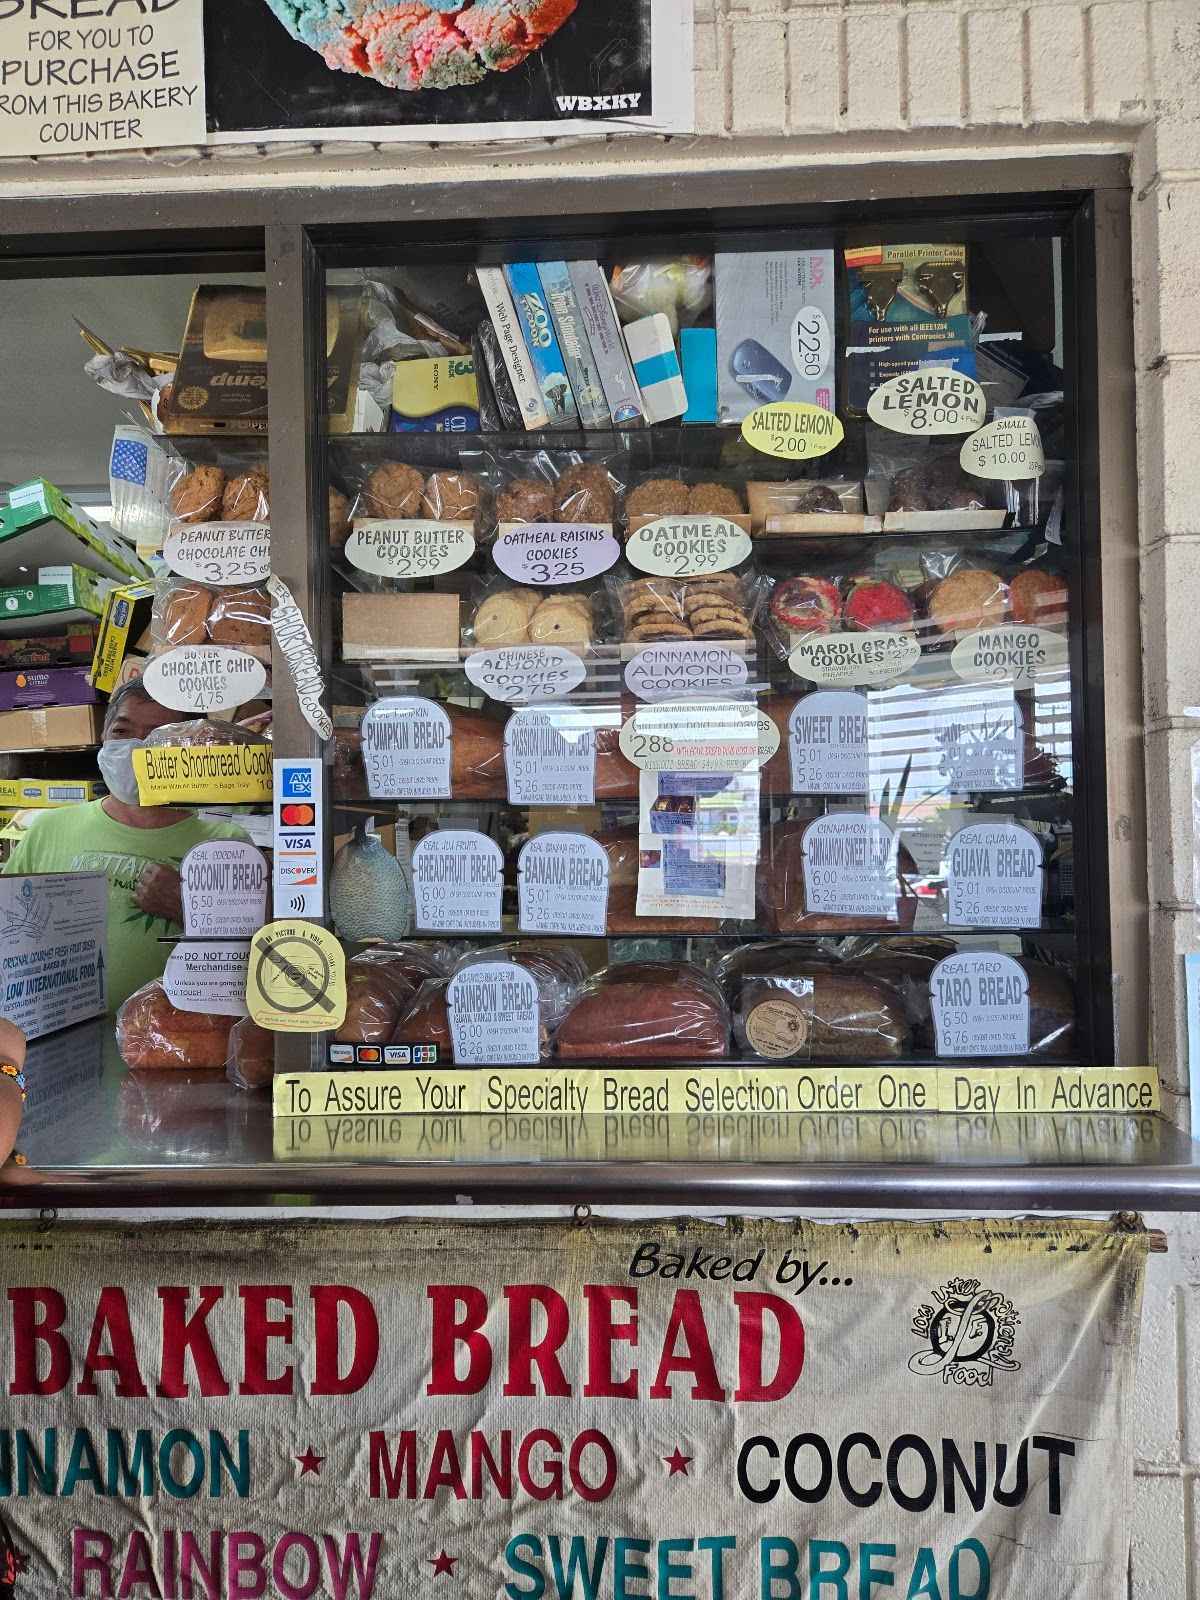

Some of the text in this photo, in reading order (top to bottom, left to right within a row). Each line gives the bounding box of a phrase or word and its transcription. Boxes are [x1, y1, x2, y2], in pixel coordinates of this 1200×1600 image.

[28, 24, 154, 50] FOR YOU TO
[1, 50, 180, 87] PURCHASE
[53, 85, 198, 114] THIS BAKERY
[556, 93, 641, 111] WBXKY
[39, 118, 142, 143] COUNTER
[887, 251, 916, 259] Parallel
[917, 249, 943, 257] Printer
[519, 297, 540, 348] TYCOON
[525, 292, 552, 348] ZOO
[893, 325, 909, 333] with
[496, 301, 526, 383] Web Page Designer
[797, 314, 821, 376] $22.50
[868, 335, 894, 344] printers
[911, 333, 946, 341] Centronics
[896, 375, 976, 394] SALTED
[883, 393, 978, 414] LEMON
[752, 411, 834, 435] SALTED LEMON
[904, 408, 958, 429] $8.00
[996, 420, 1027, 431] SMALL
[771, 434, 807, 453] $2.00
[972, 434, 1013, 452] SALTED
[180, 529, 271, 544] PEANUT BUTTER
[357, 528, 465, 546] PEANUT BUTTER
[503, 529, 605, 546] OATMEAL RAISINS
[639, 523, 741, 542] OATMEAL
[177, 546, 246, 560] CHOCOLATE
[376, 544, 449, 559] COOKIES
[526, 547, 579, 562] COOKIES
[652, 539, 727, 558] COOKIES
[195, 561, 257, 582] $3.25
[387, 556, 441, 577] $2.99
[521, 562, 585, 583] $3.25
[664, 554, 719, 575] $2.99
[272, 605, 324, 695] SHORTBREAD
[800, 636, 908, 656] MARDI GRAS
[978, 633, 1040, 649] MANGO
[481, 656, 563, 671] ALMOND
[498, 648, 546, 661] CHINESE
[642, 650, 732, 663] CINNAMON
[810, 652, 884, 667] COOKIES
[974, 650, 1046, 667] COOKIES
[161, 658, 255, 677] CHOCLATE CHIP
[632, 664, 742, 677] ALMOND
[27, 674, 50, 682] SUMO
[178, 675, 228, 693] COOKIES
[483, 670, 568, 686] COOKIES
[187, 691, 224, 711] $4.75
[367, 721, 445, 751] PUMPKIN BREAD
[795, 715, 833, 745] SWEET
[512, 728, 539, 756] PASSION
[145, 746, 241, 780] Butter Shortbread
[370, 754, 394, 771] $5.01
[797, 747, 821, 764] $5.01
[513, 760, 537, 776] $5.01
[797, 766, 822, 783] $5.26
[291, 773, 312, 783] AM
[372, 773, 396, 789] $5.26
[514, 779, 538, 795] $5.26
[817, 823, 867, 835] CINNAMON
[284, 838, 312, 849] VISA
[423, 840, 478, 851] REAL FRUITS
[960, 833, 1017, 846] REAL GUAVA
[192, 849, 246, 861] REAL COCONUT
[808, 837, 867, 867] CINNAMON SWEET
[280, 867, 315, 875] DISCOVER
[418, 854, 497, 883] BREADFRUIT BREAD
[524, 855, 604, 886] BANANA BREAD
[952, 847, 991, 878] GUAVA
[997, 848, 1036, 878] BREAD
[187, 863, 263, 892] COCONUT BREAD
[810, 868, 837, 886] $6.00
[420, 884, 446, 902] $6.00
[526, 886, 550, 904] $5.01
[811, 887, 837, 904] $6.26
[953, 880, 979, 898] $5.01
[189, 893, 213, 911] $6.50
[953, 899, 980, 917] $5.26
[189, 912, 213, 929] $6.76
[526, 905, 550, 922] $5.26
[184, 952, 223, 961] DO NOT
[941, 962, 1002, 975] REAL TARO
[6, 980, 24, 1001] LOW
[453, 981, 533, 1013] RAINBOW BREAD
[937, 976, 1022, 1007] TARO BREAD
[498, 1011, 514, 1021] SWEET
[285, 1074, 1153, 1114] To Assure Your Specialty Bread Selection Order One Day In Advance
[629, 1242, 855, 1296] Baked by...
[7, 1285, 806, 1403] BAKED BREAD
[943, 1363, 994, 1387] Food
[369, 1429, 617, 1501] MANGO
[737, 1432, 1075, 1516] COCONUT
[72, 1527, 383, 1600] RAINBOW
[505, 1534, 990, 1600] SWEET BREAD
